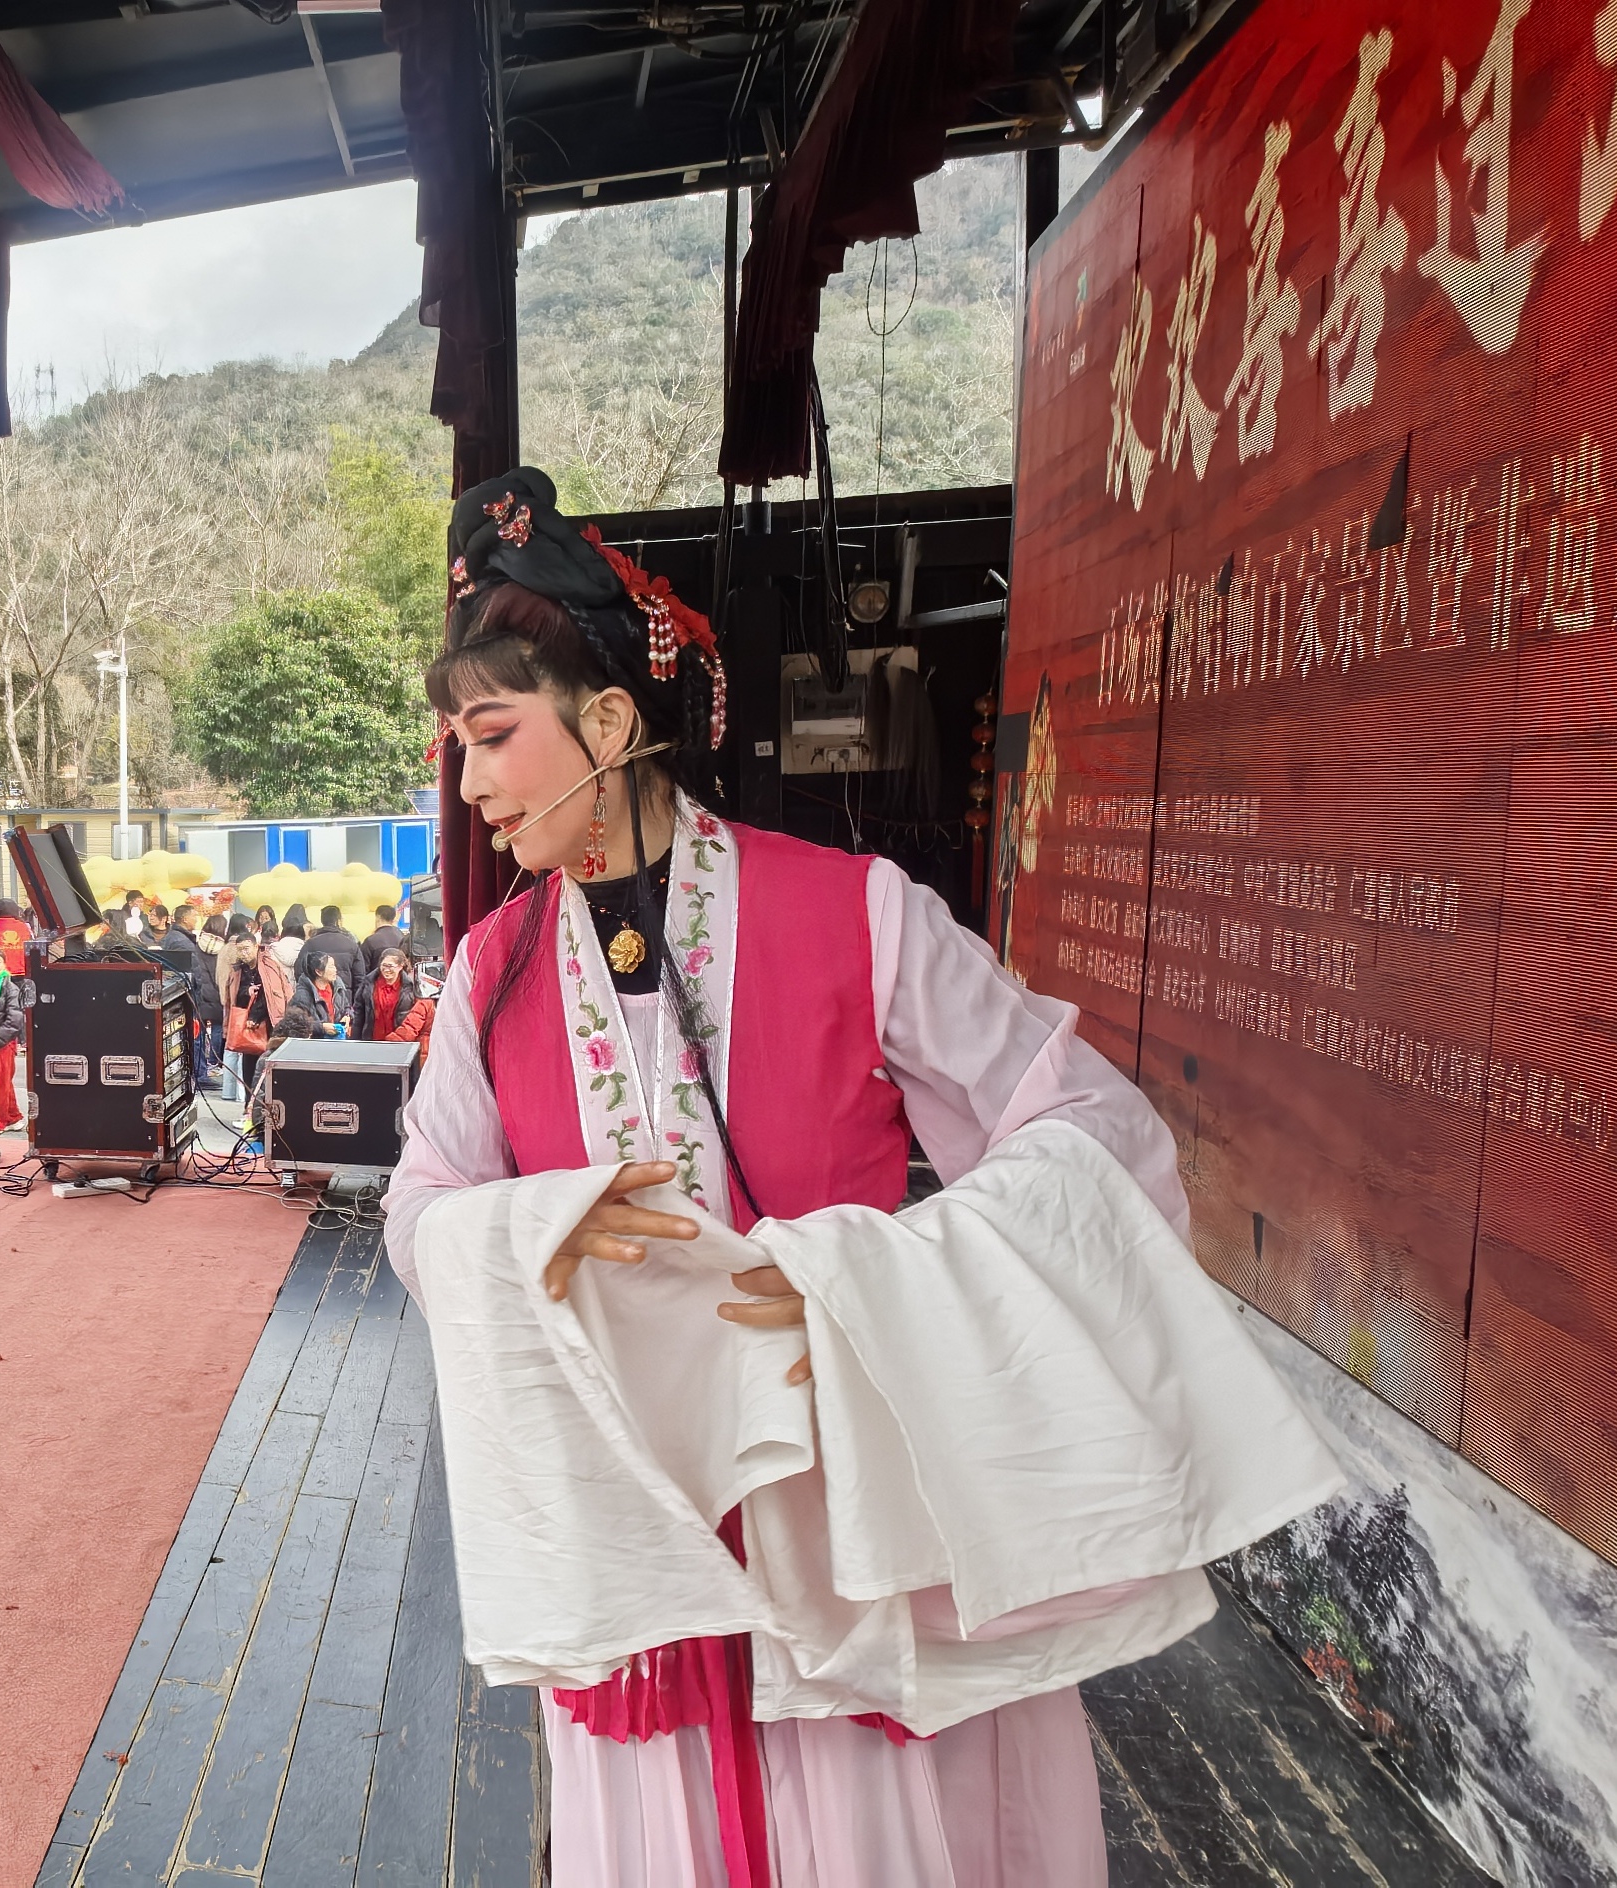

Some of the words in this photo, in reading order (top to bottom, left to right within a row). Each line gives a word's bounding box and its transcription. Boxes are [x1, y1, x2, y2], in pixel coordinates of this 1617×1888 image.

[1348, 867, 1461, 933] 仁里镇人民政府
